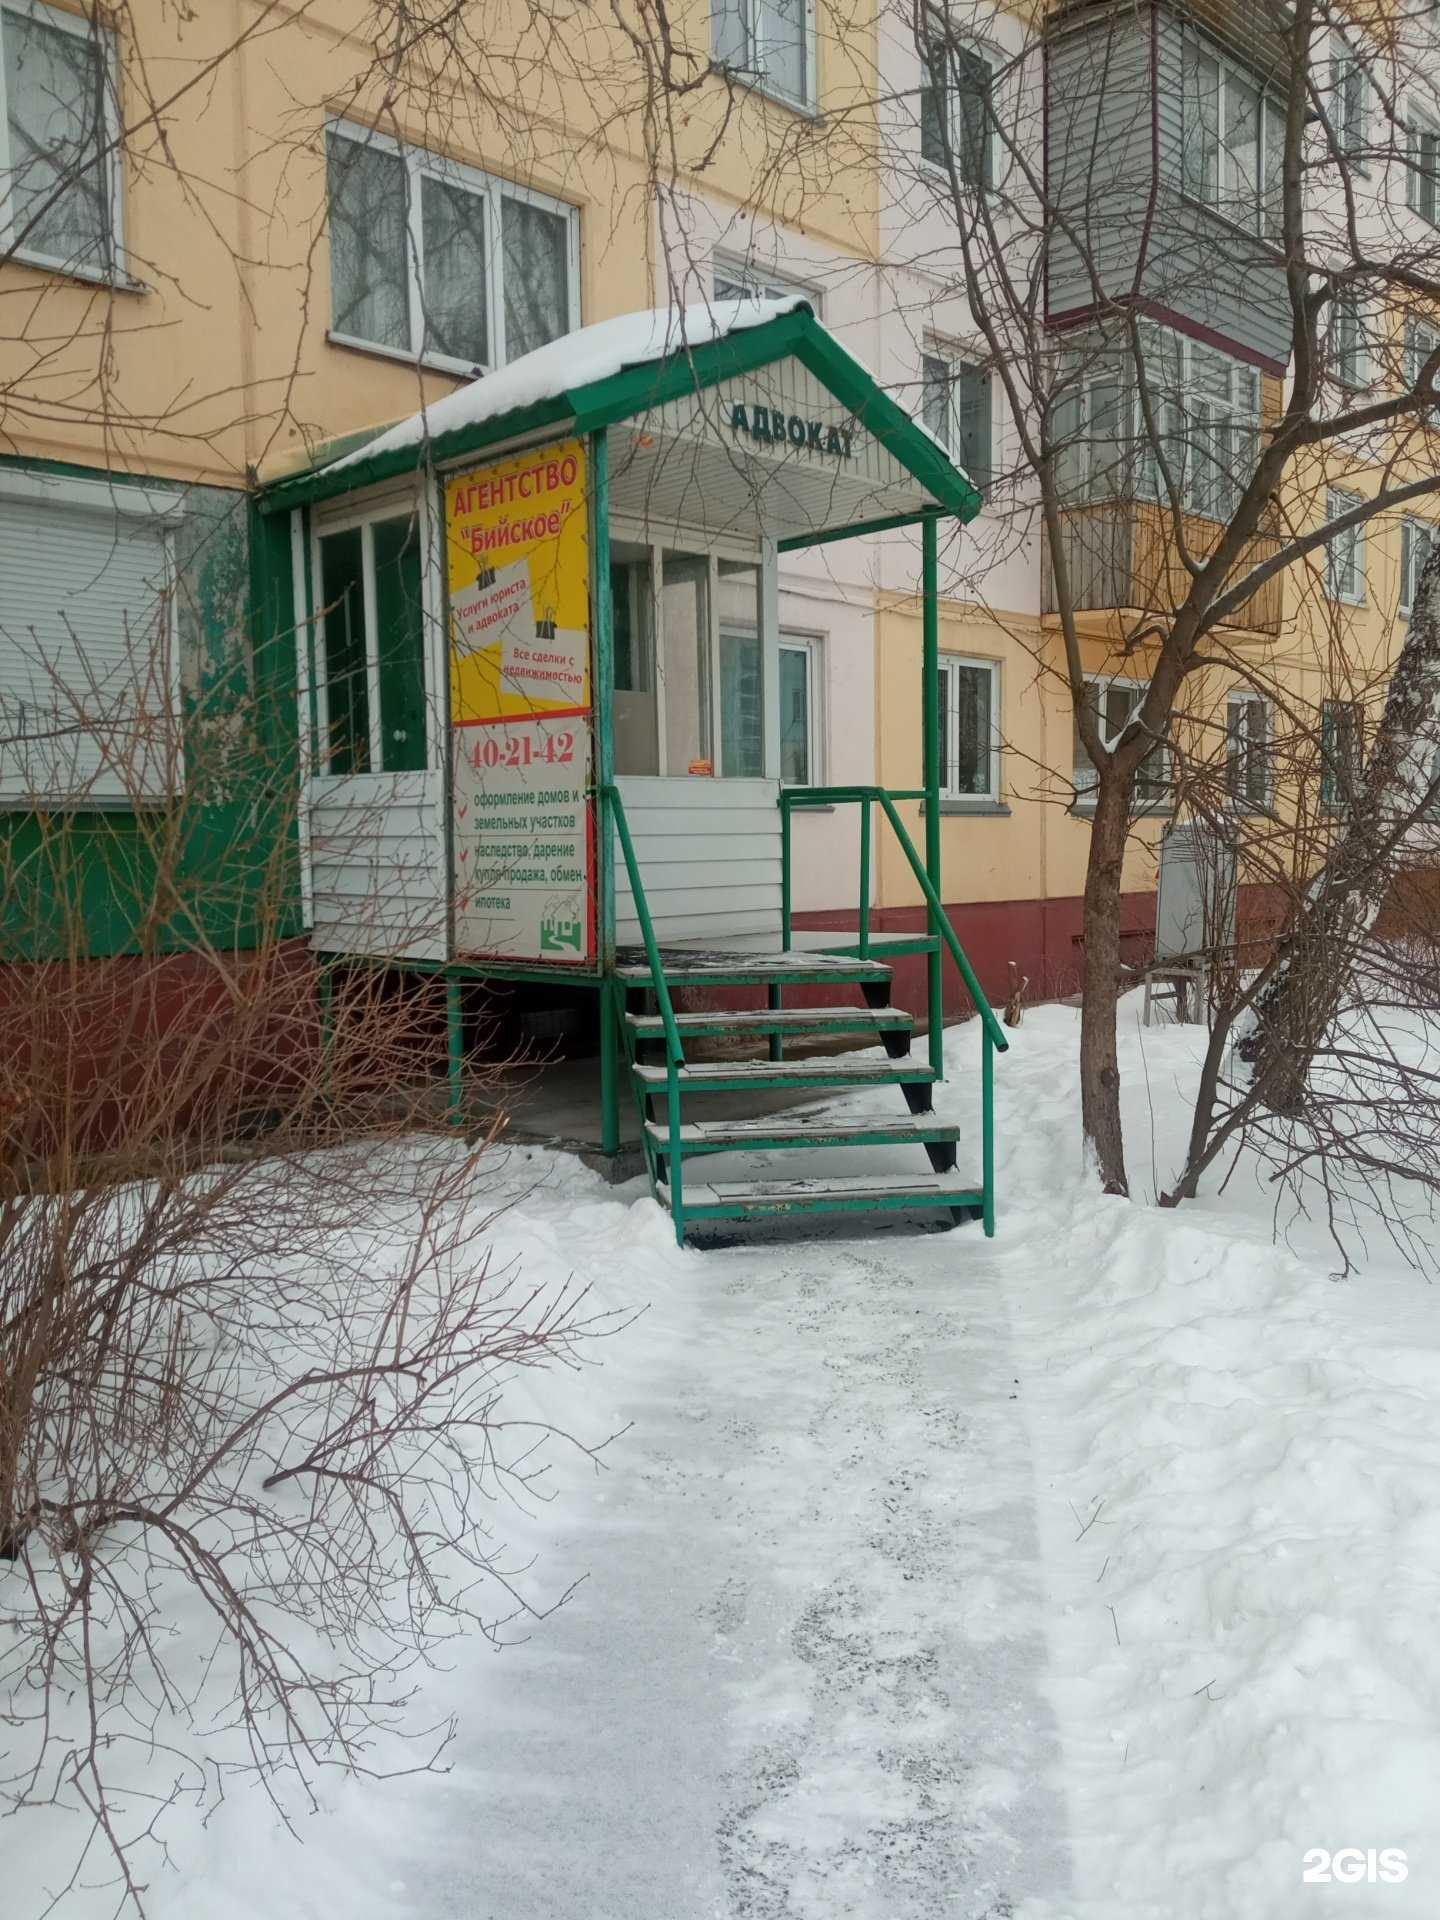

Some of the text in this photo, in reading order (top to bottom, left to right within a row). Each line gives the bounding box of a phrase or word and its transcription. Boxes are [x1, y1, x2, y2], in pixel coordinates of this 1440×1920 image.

[731, 403, 854, 459] АДВОКАТ
[453, 456, 577, 517] АГЕНТСТВО
[461, 500, 571, 554] "Бийское"
[456, 579, 527, 620] Услуги юриста
[475, 603, 520, 631] адвоката
[513, 648, 575, 666] Все сделки с
[503, 665, 583, 684] недвижимостью
[469, 732, 574, 768] 40-21-42
[474, 789, 580, 808] оформление домов и
[474, 815, 576, 833] земельных участков
[533, 844, 576, 860] дарение
[551, 865, 582, 881] обмен
[475, 896, 511, 910] ипотека
